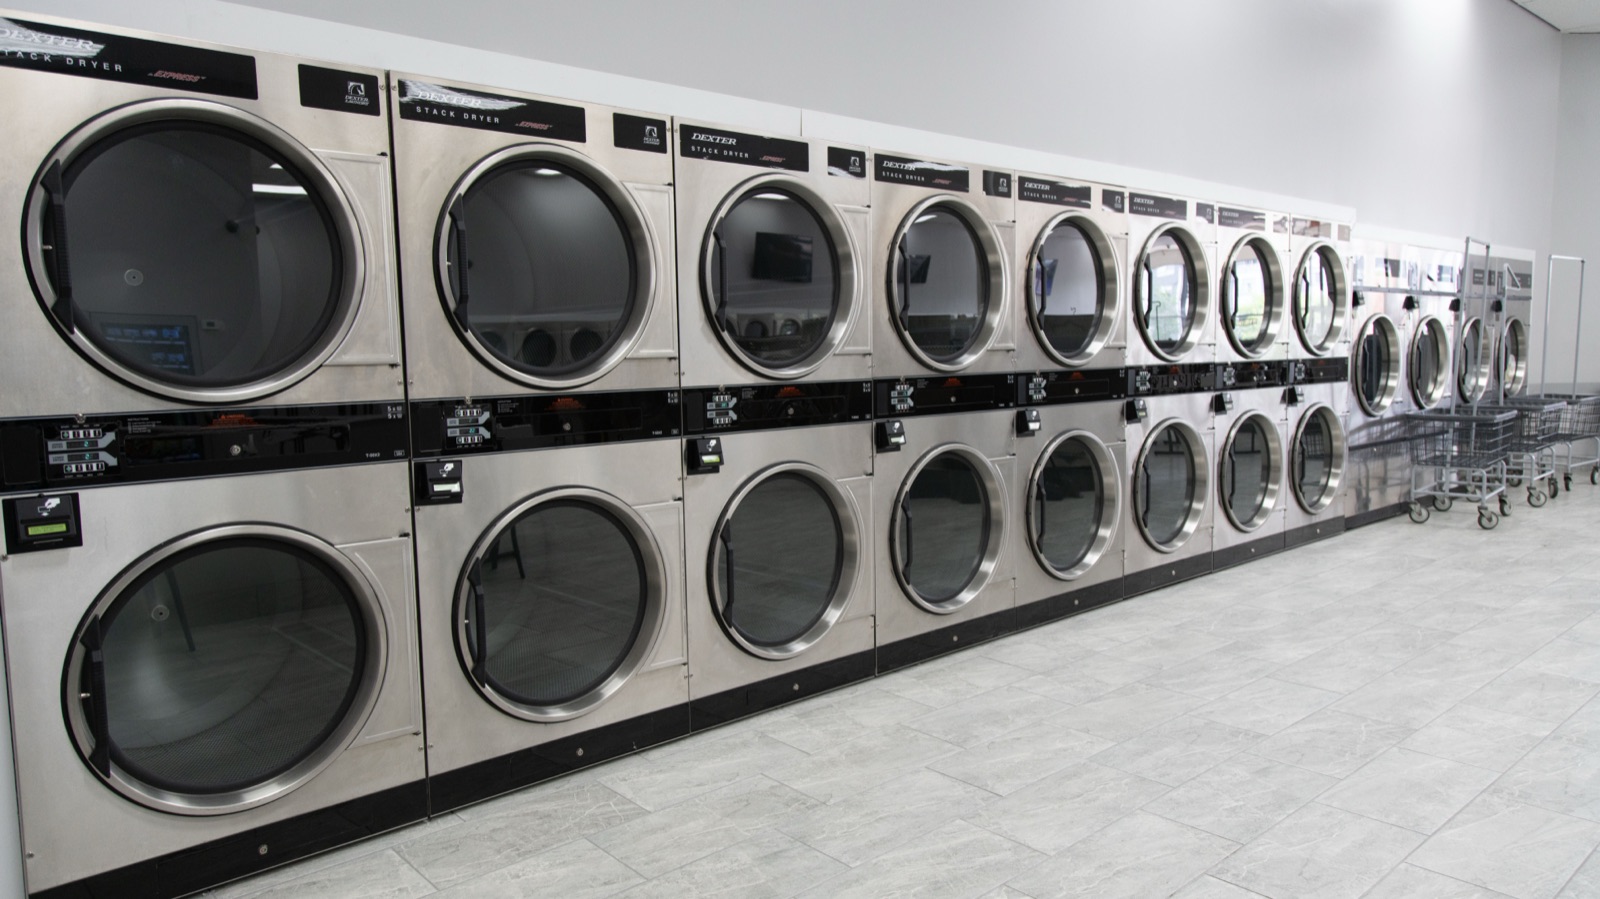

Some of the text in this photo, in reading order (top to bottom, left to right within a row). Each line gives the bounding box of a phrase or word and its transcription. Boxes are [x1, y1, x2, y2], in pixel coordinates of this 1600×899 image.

[0, 29, 94, 51] DEXTER
[66, 57, 123, 72] DRYER
[417, 90, 481, 106] DEXTER
[416, 106, 500, 123] STACK DRYER
[691, 132, 737, 146] DEXTER
[691, 145, 719, 155] STACK
[723, 149, 750, 159] DRYER
[882, 160, 916, 171] DEXTER
[882, 171, 903, 179] STACK
[1024, 181, 1051, 191] DEXTER
